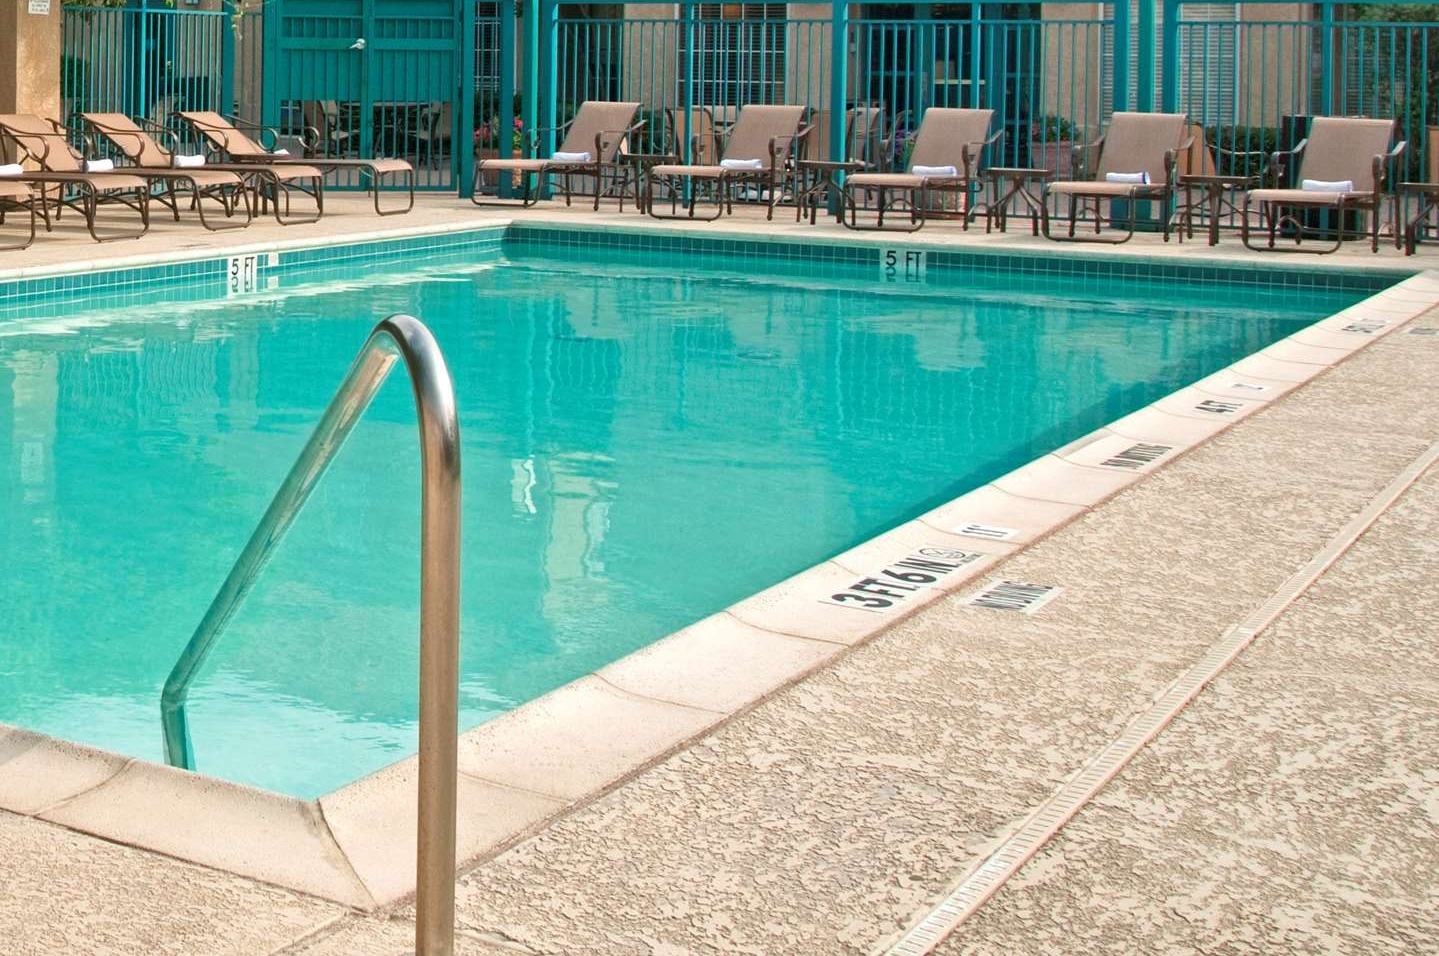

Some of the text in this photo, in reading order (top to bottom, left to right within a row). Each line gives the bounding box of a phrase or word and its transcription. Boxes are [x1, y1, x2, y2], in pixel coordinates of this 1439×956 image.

[231, 256, 255, 276] 5 FT
[886, 250, 922, 267] 5 FT
[831, 593, 892, 608] 3
[882, 569, 937, 584] 6
